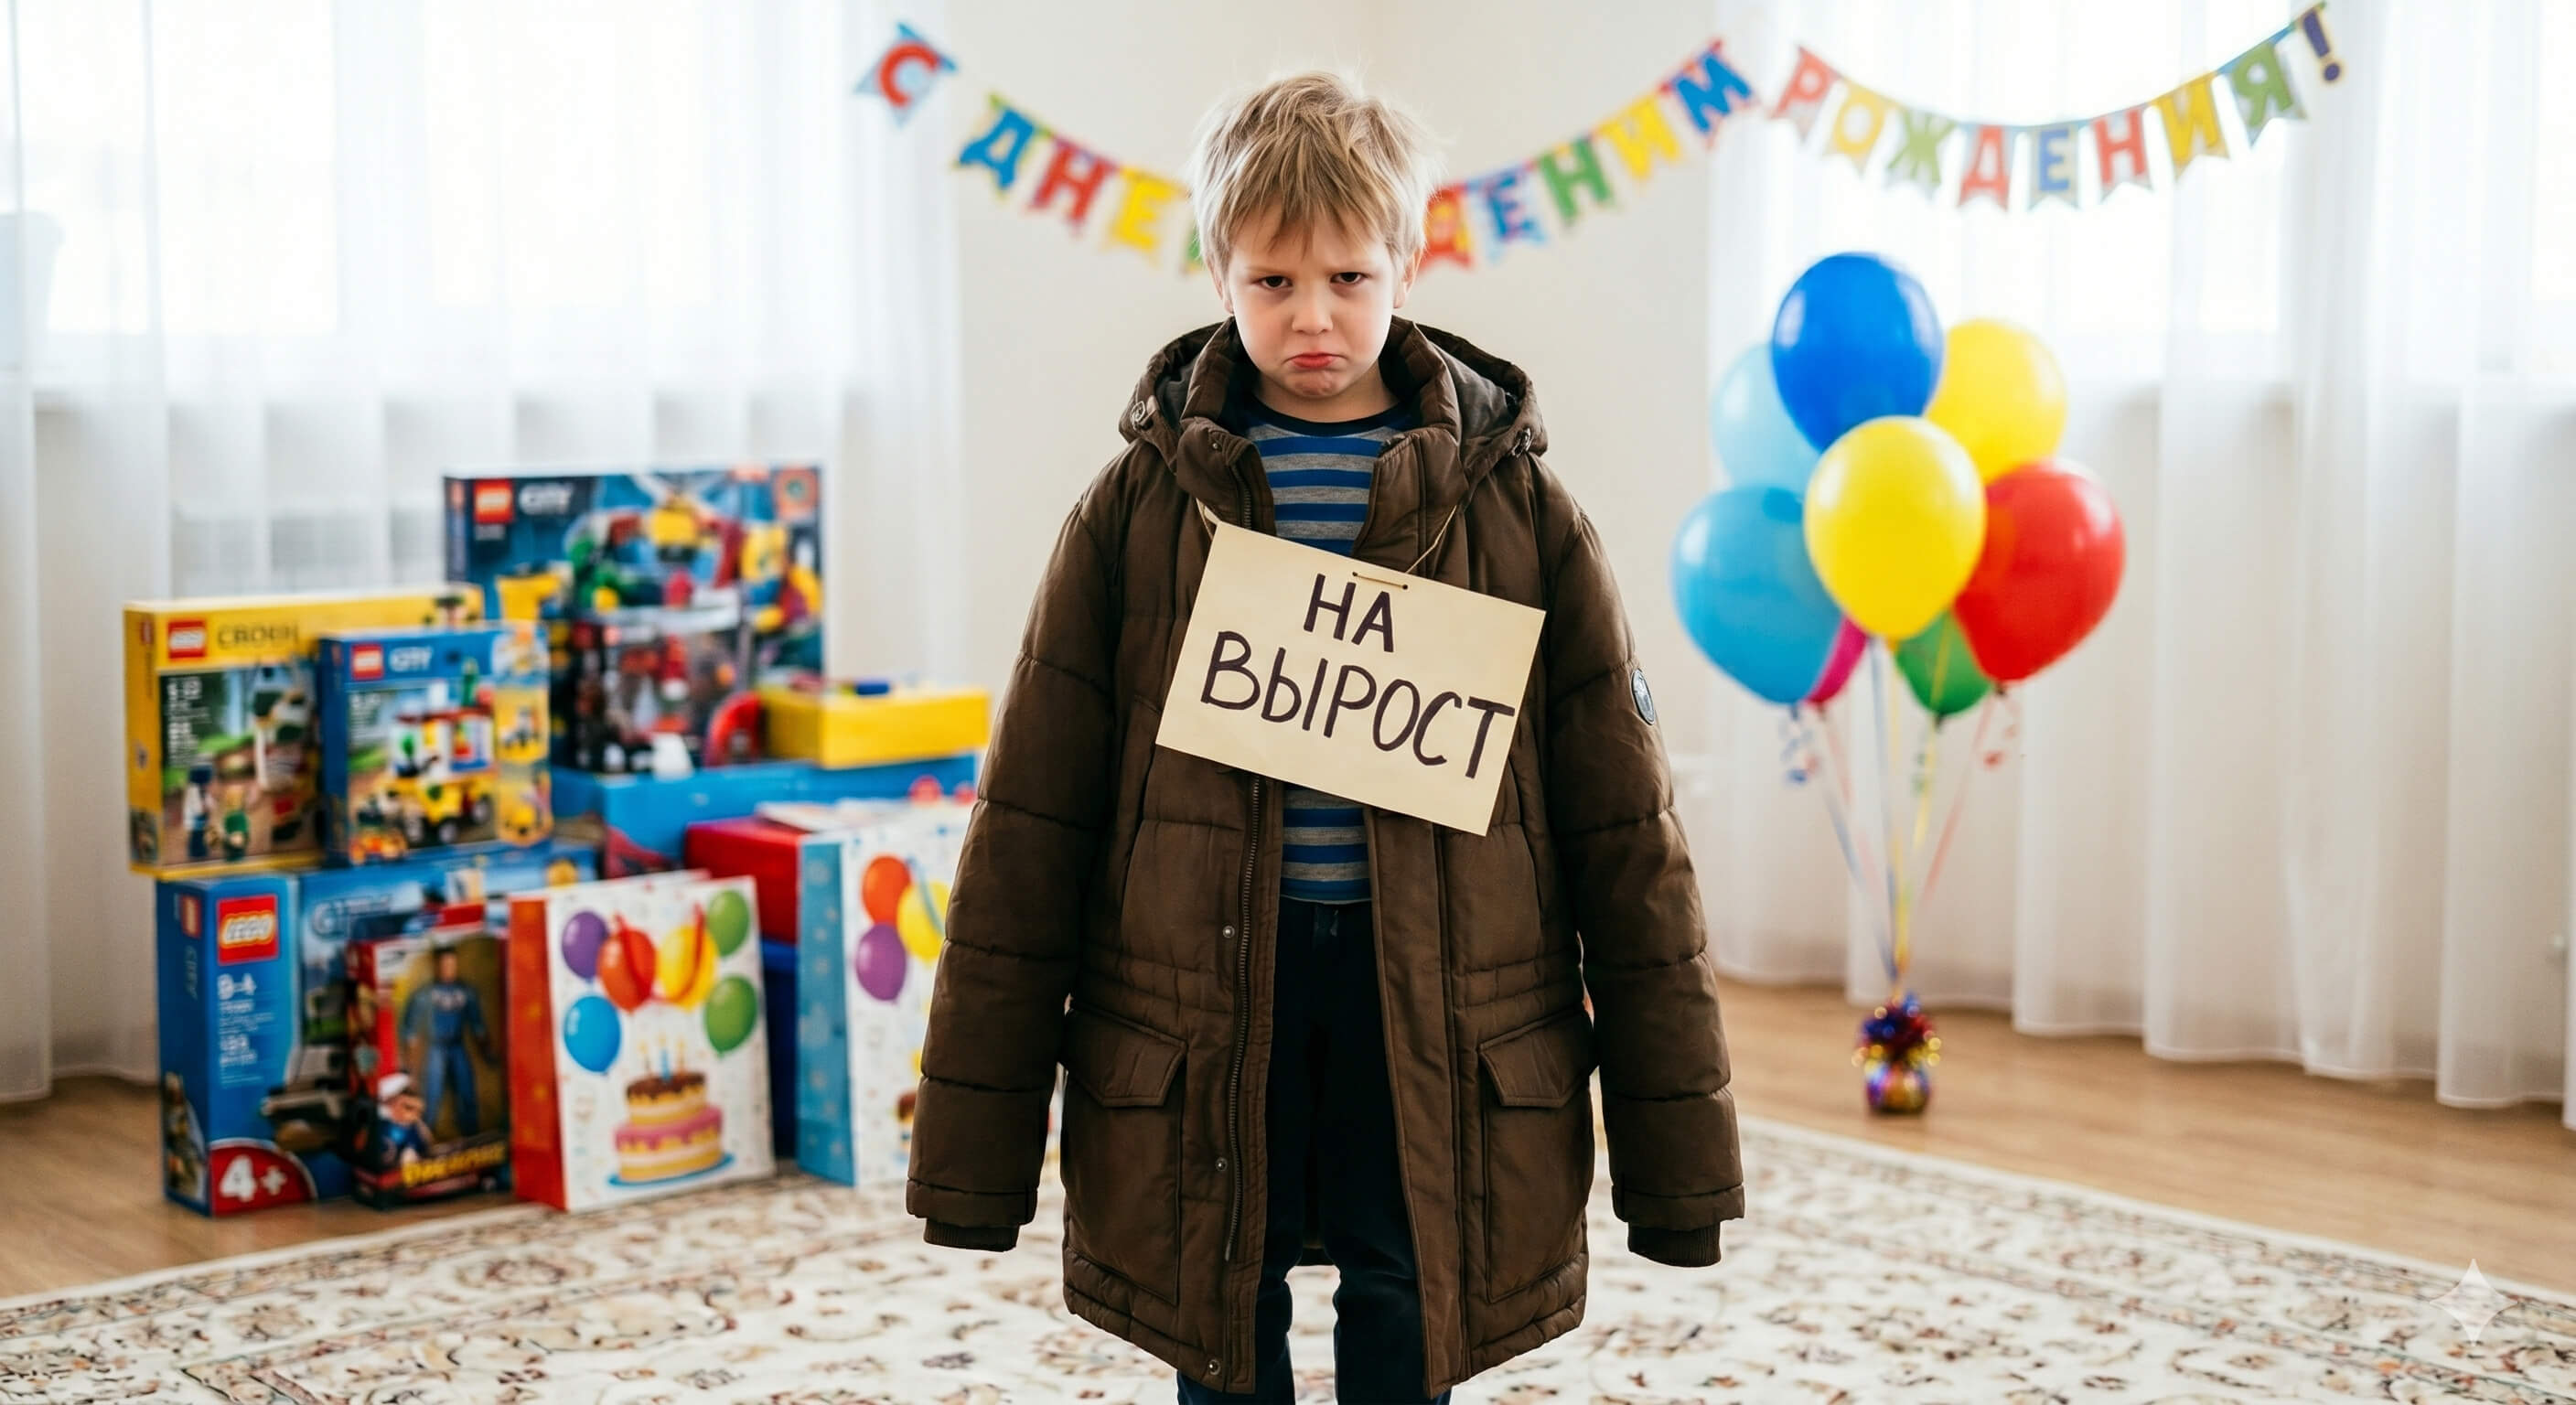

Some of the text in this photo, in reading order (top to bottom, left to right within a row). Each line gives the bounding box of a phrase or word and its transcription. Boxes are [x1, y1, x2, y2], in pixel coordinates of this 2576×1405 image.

[875, 40, 940, 110] С
[958, 102, 1203, 260] ДНЕ
[1771, 7, 2344, 209] РОЖДЕНИЯ!
[1303, 573, 1394, 653] НА
[1200, 630, 1516, 779] ВЫРОСТ
[219, 1153, 287, 1203] 4+
